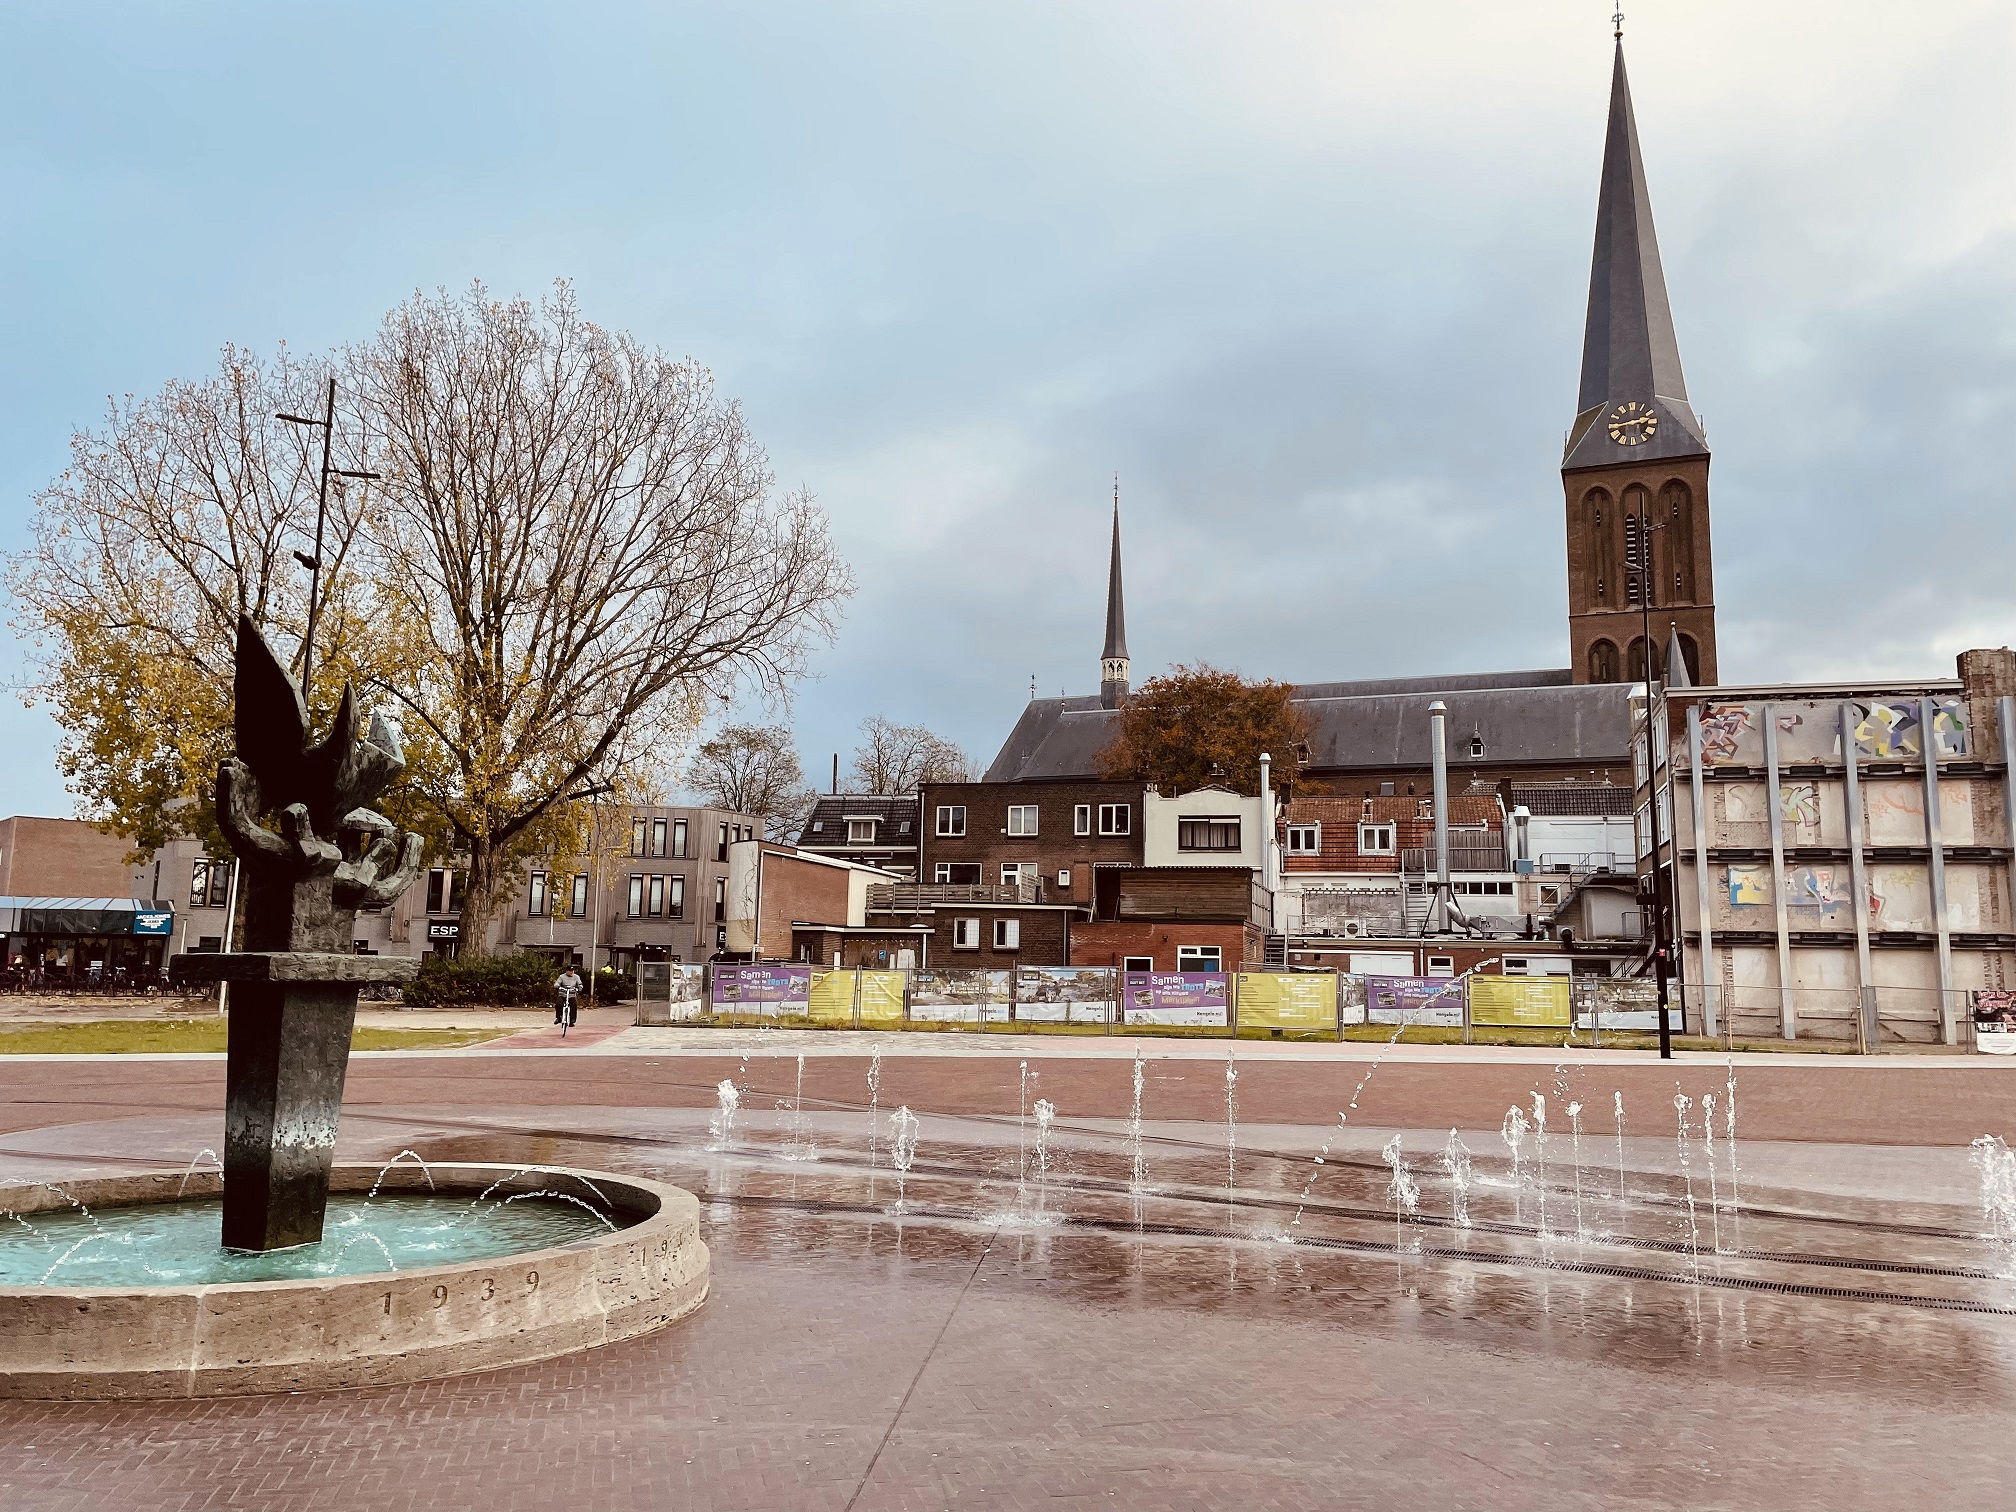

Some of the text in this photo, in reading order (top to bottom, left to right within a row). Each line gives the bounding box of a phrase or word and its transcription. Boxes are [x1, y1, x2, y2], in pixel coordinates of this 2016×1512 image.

[740, 970, 771, 980] Samen
[1151, 975, 1185, 986] Samen
[1393, 979, 1424, 989] Samen
[1181, 983, 1204, 991] TROTS
[378, 1270, 541, 1316] 1939
